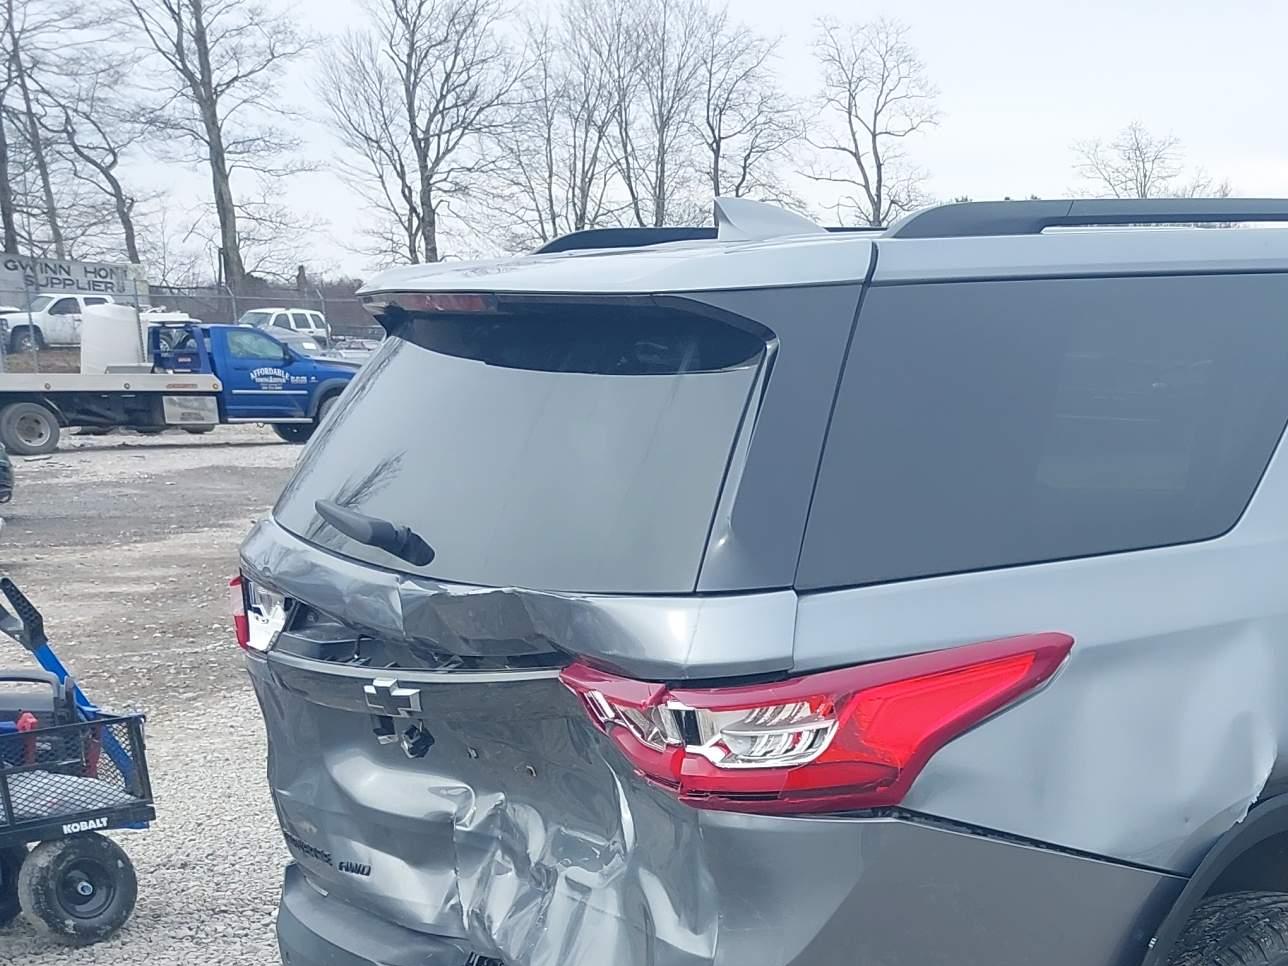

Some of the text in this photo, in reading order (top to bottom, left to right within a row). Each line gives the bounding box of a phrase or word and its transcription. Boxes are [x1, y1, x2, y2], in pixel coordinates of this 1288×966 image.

[4, 260, 71, 276] GWINN
[250, 367, 290, 381] AFFORDABLE
[62, 817, 108, 835] KOBALT
[338, 861, 372, 877] AWD
